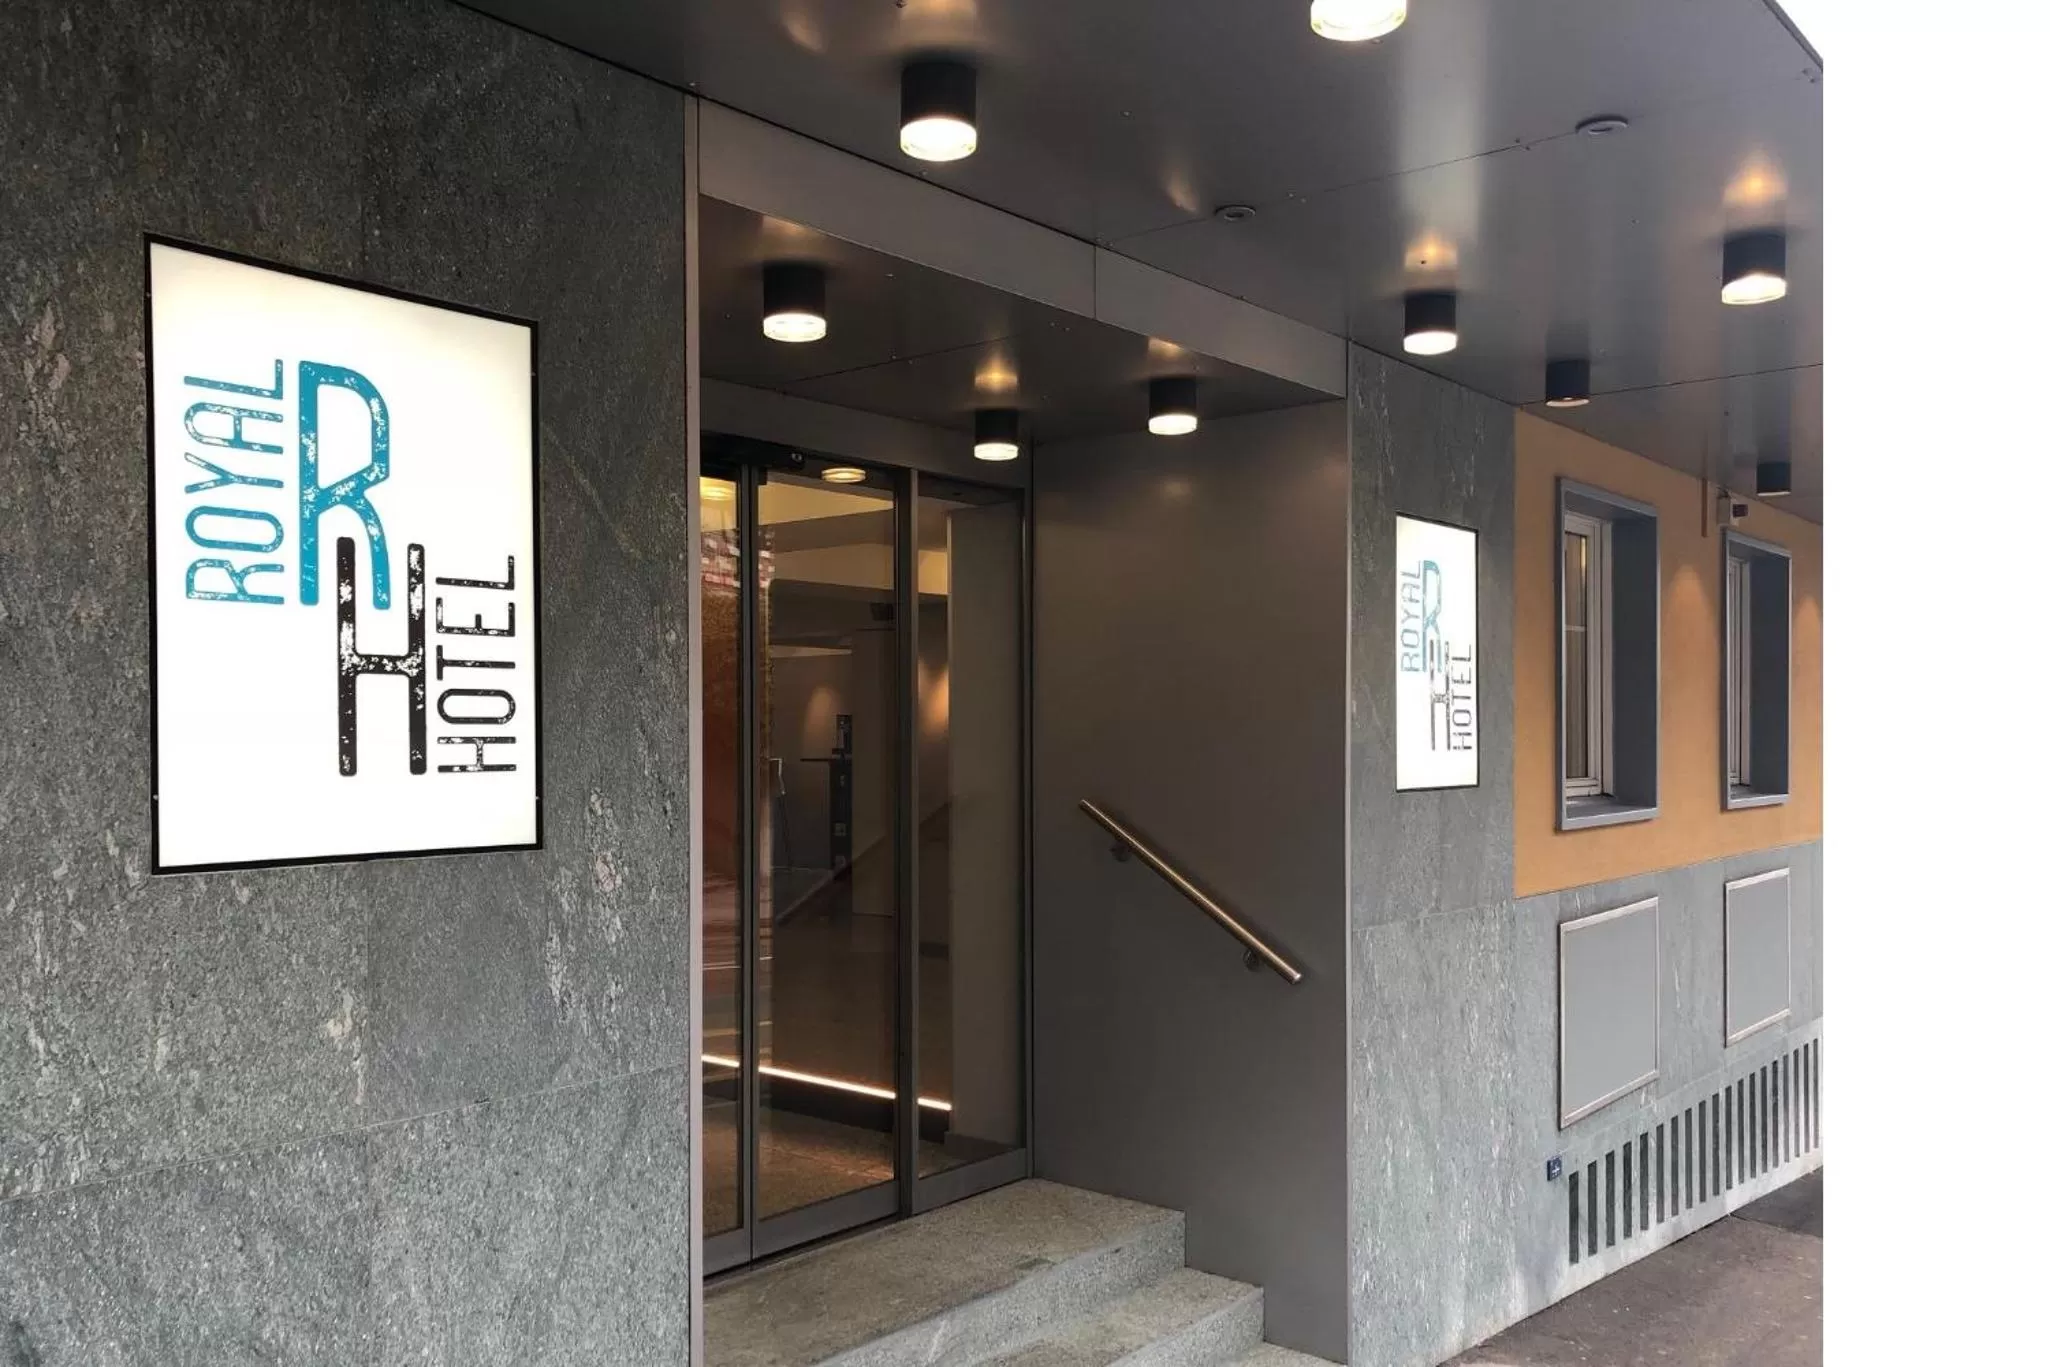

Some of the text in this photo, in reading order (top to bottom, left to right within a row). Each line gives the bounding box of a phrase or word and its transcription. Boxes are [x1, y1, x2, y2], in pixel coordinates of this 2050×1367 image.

[185, 359, 284, 604] ROYAL
[436, 555, 517, 773] HOTEL
[1400, 560, 1421, 672] ROYAL
[1452, 644, 1472, 750] HOTEL
